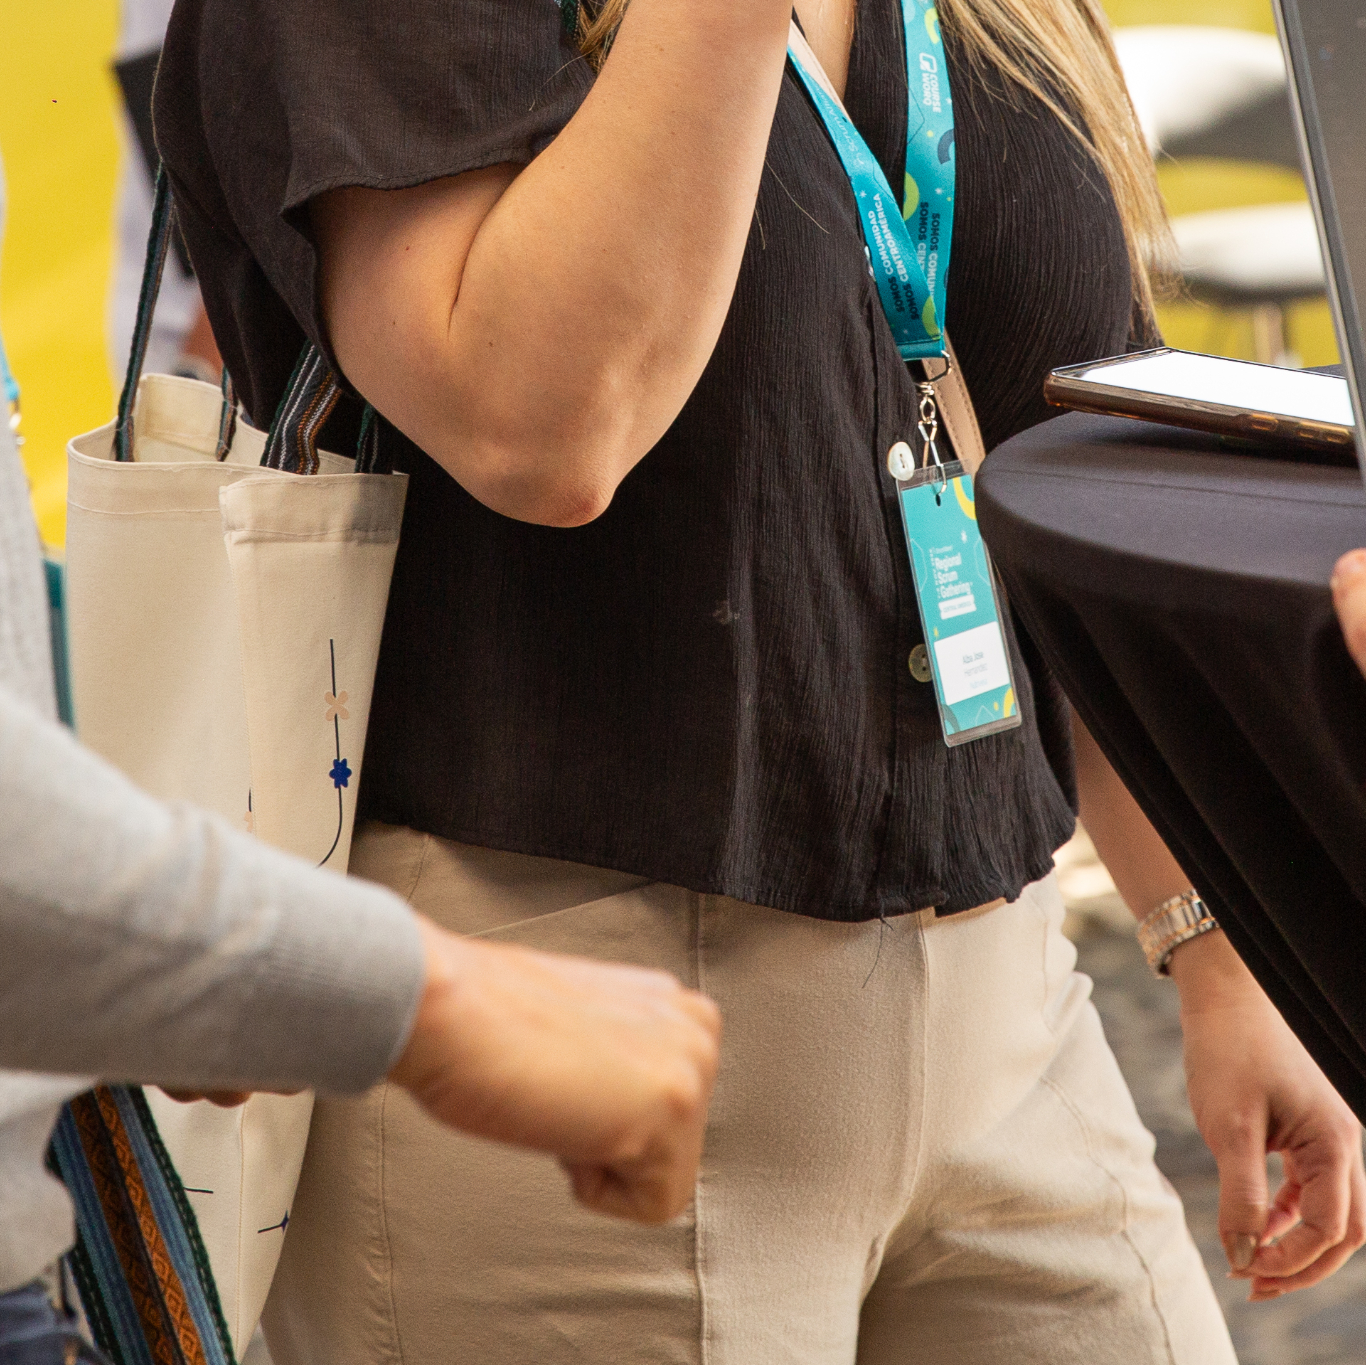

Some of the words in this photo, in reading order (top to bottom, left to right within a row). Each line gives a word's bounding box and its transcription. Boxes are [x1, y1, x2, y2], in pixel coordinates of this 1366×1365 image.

[929, 73, 942, 113] COURSE
[873, 193, 909, 282] CENTROAMÉRICA
[918, 201, 929, 241] SOMOS
[929, 212, 940, 251] SOMOS
[868, 210, 894, 275] COMUNIDAD
[926, 252, 939, 294] COMUN
[888, 276, 905, 313] SOMOS
[903, 283, 920, 320] SOMOS
[935, 552, 962, 571] Regional
[937, 570, 959, 585] Scrum
